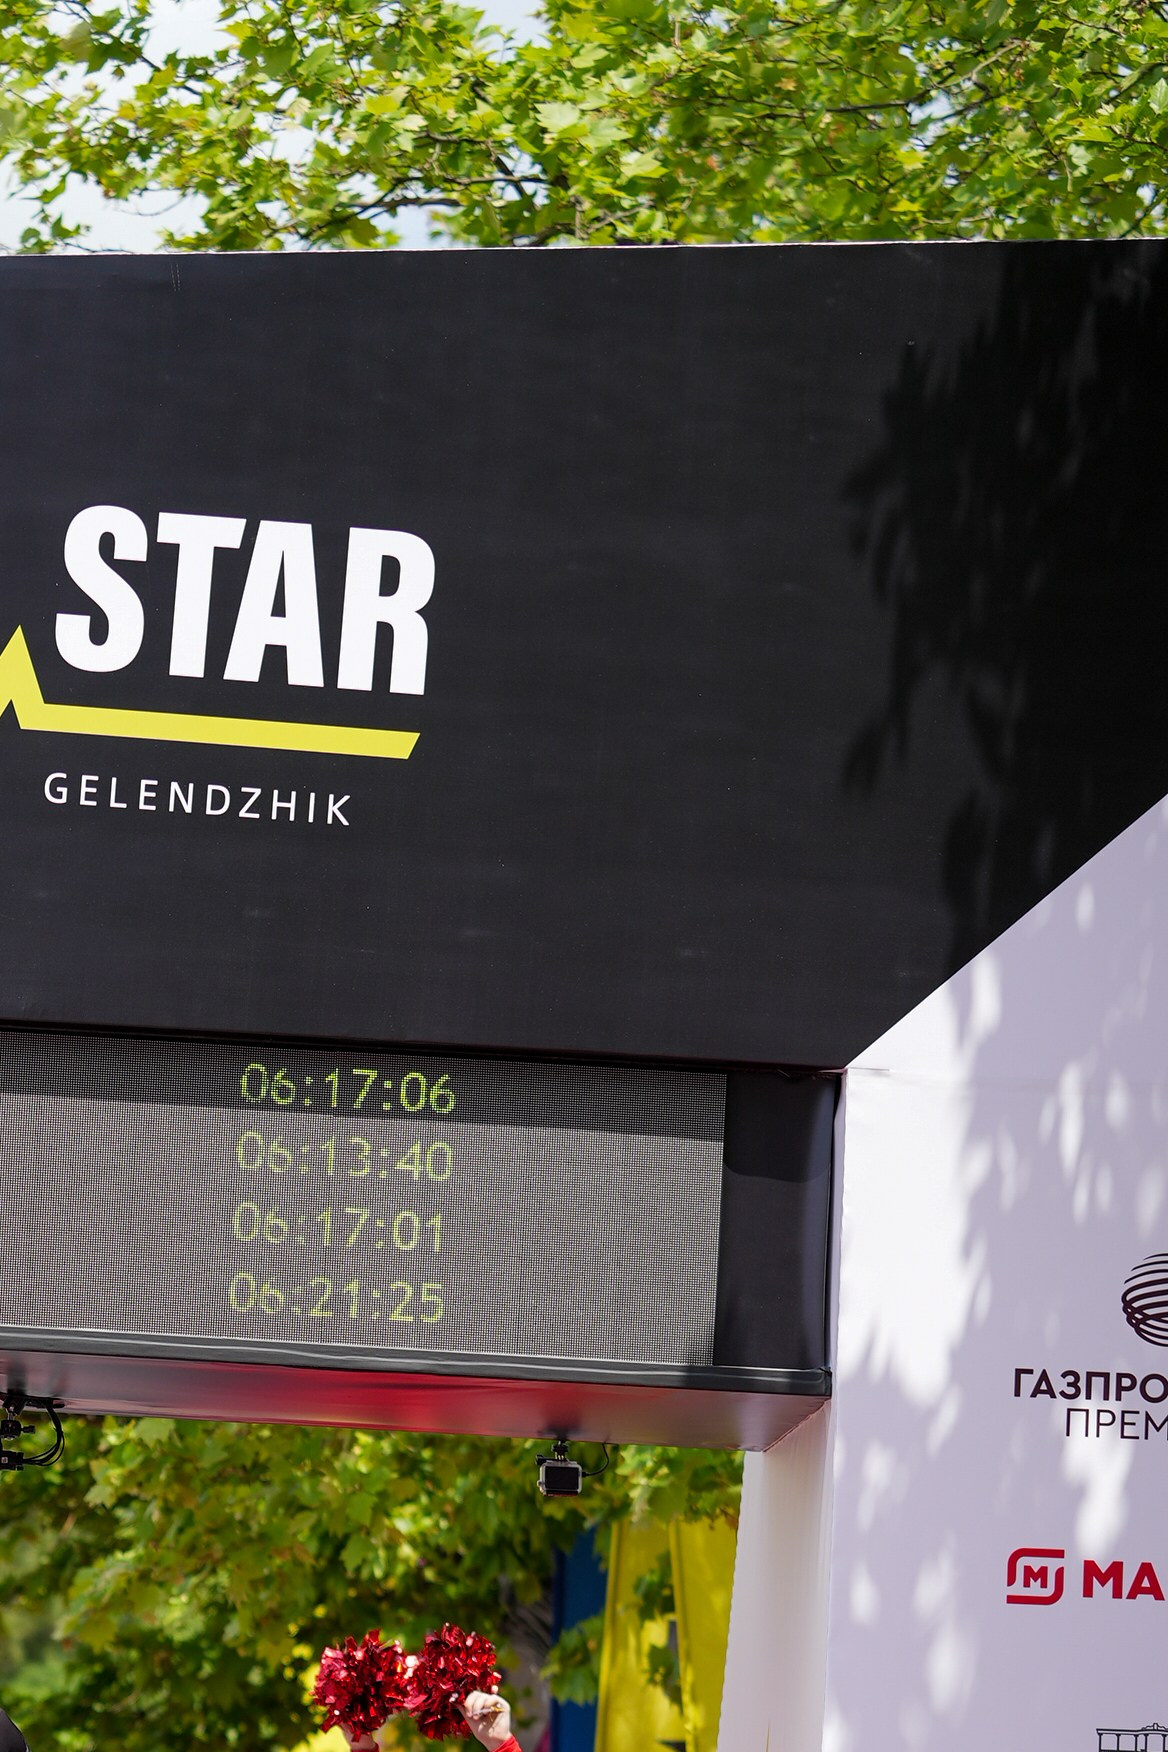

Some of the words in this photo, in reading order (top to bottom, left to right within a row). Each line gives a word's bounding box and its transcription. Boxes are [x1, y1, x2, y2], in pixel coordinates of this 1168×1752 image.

[54, 504, 437, 698] STAR
[42, 771, 353, 827] GELENDZHIK
[239, 1062, 457, 1116] 06:17:06
[236, 1131, 455, 1184] 06:13:40
[232, 1200, 445, 1255] 06:17:01
[228, 1271, 446, 1327] 06:21:25
[1013, 1367, 1168, 1404] ГАЗПРО
